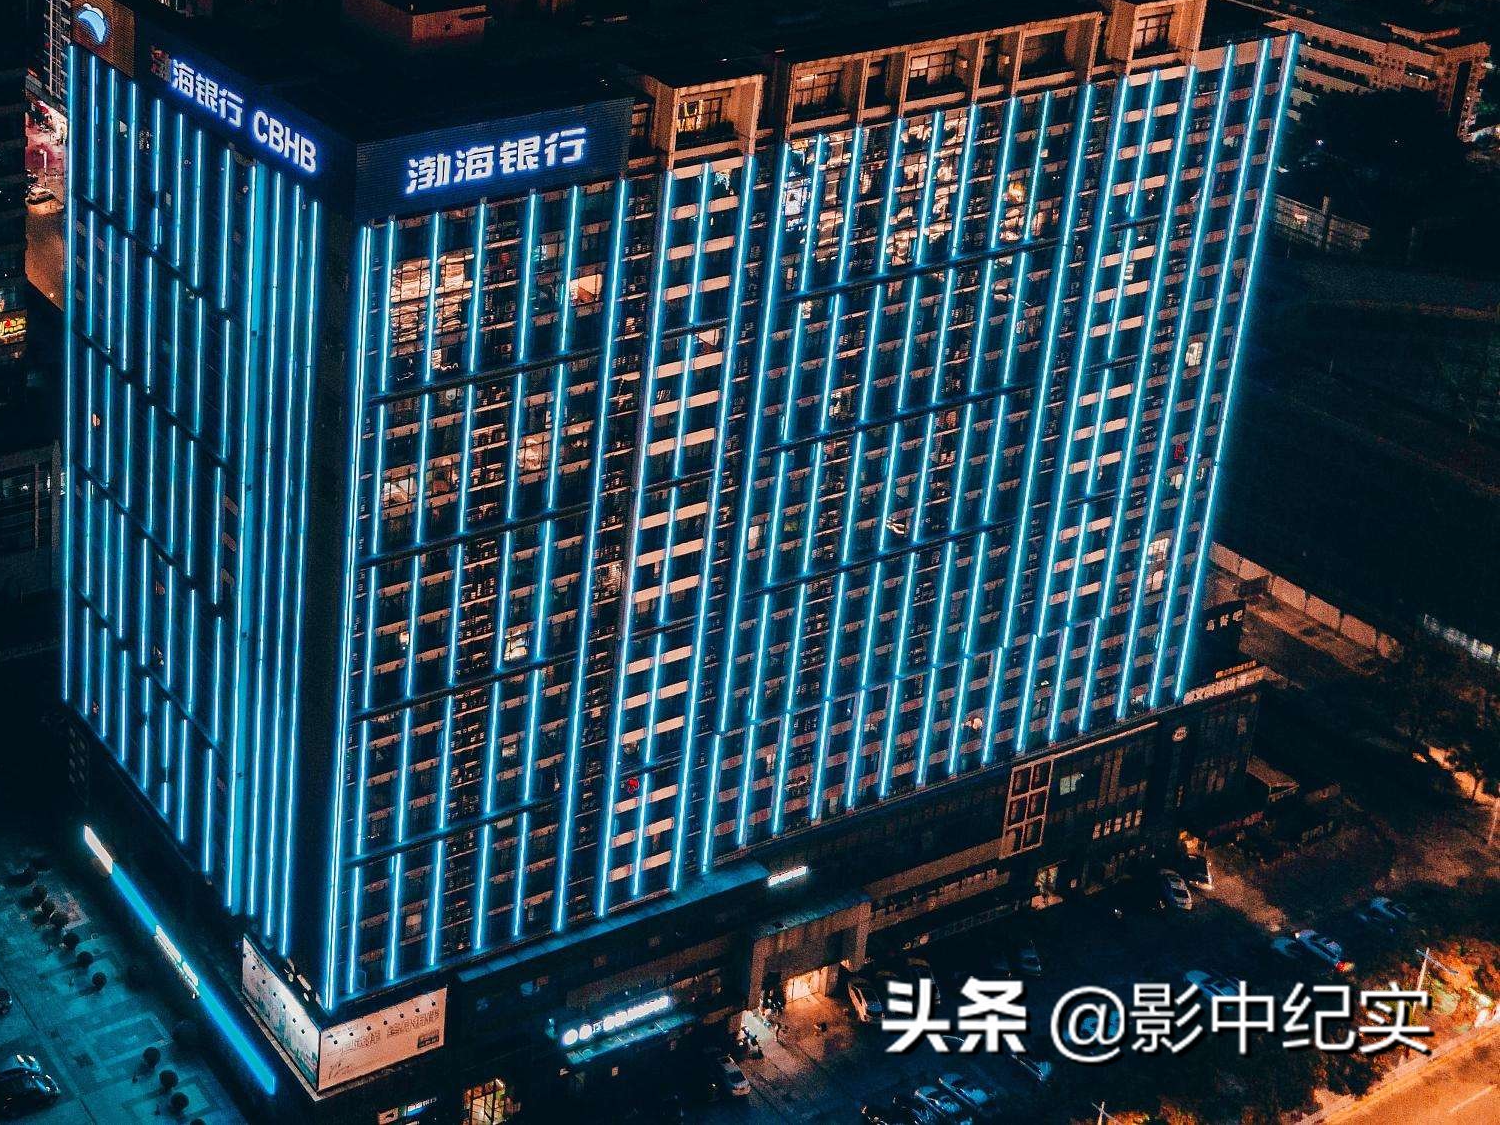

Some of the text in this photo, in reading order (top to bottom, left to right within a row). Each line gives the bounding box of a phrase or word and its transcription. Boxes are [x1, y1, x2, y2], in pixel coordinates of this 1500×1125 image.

[253, 111, 318, 173] CBHB
[405, 127, 587, 194] 渤海银行
